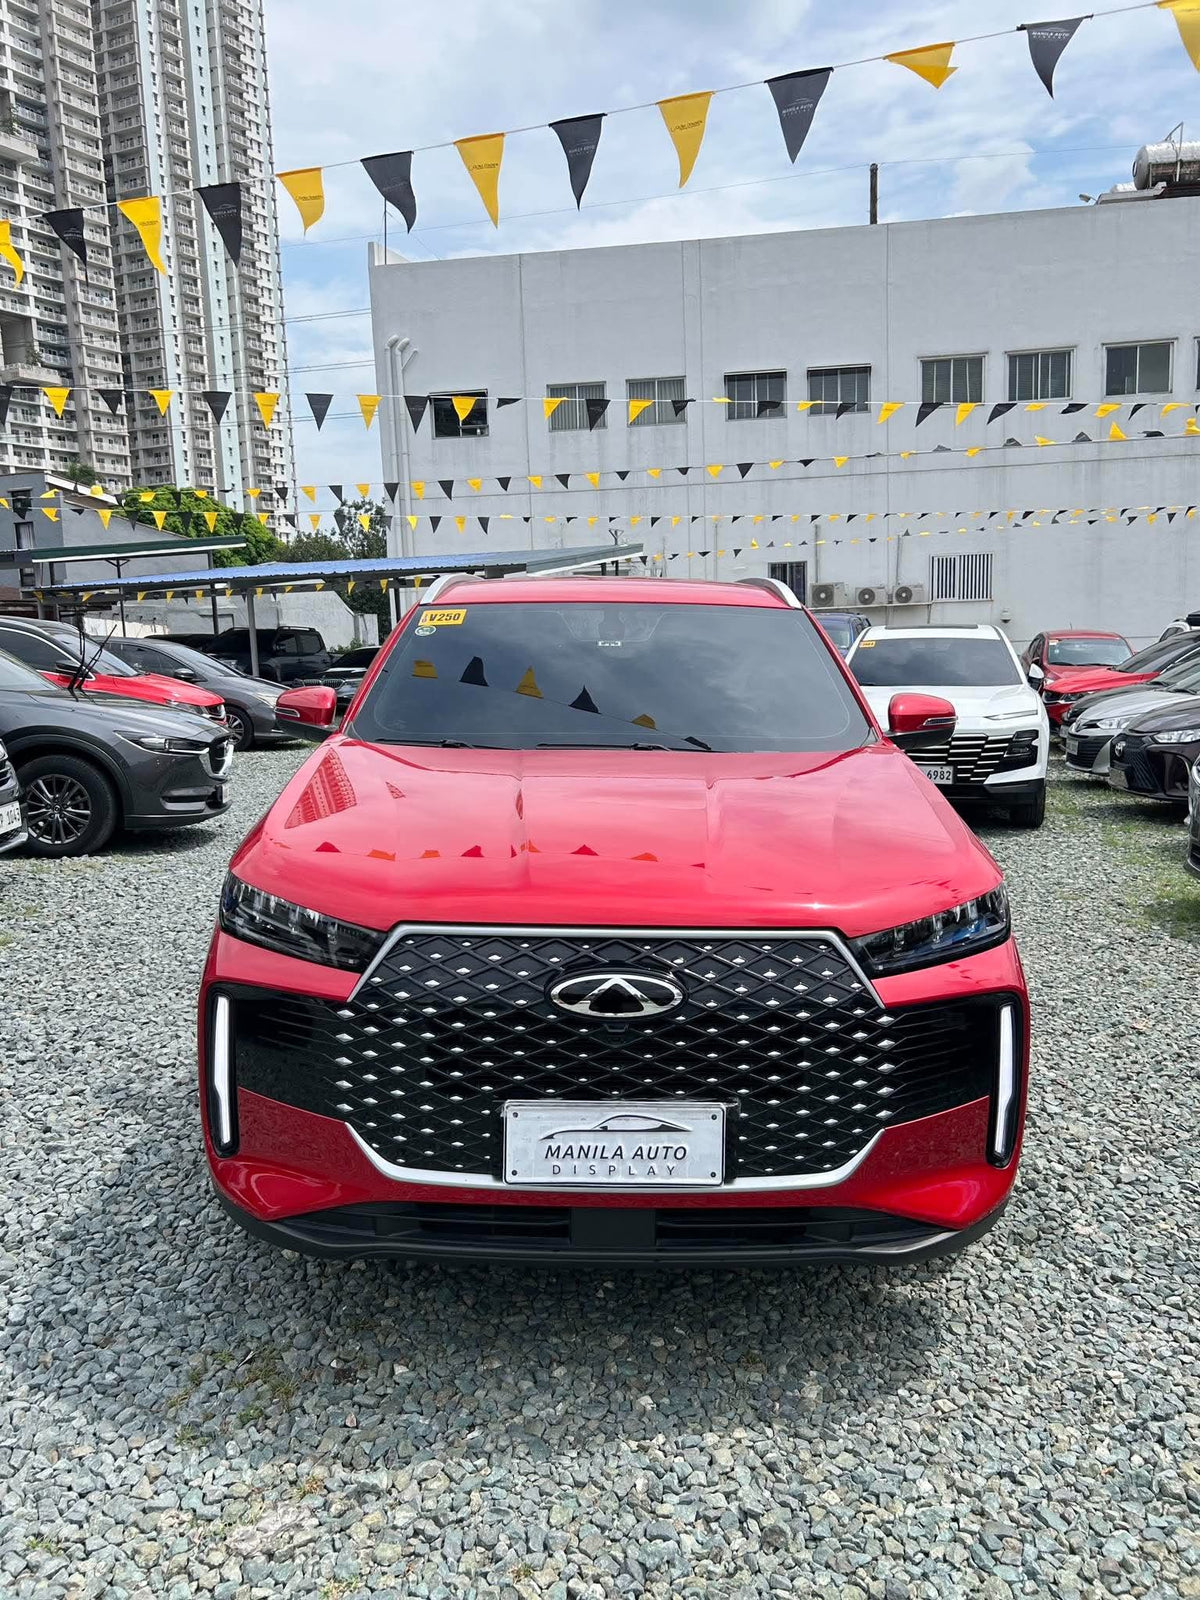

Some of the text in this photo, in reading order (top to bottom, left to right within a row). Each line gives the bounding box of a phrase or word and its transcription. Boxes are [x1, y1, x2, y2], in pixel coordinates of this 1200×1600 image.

[429, 612, 461, 622] V250
[926, 769, 952, 780] 6982
[544, 1144, 687, 1161] MANILA AUTO
[552, 1164, 676, 1176] DISPLAY
